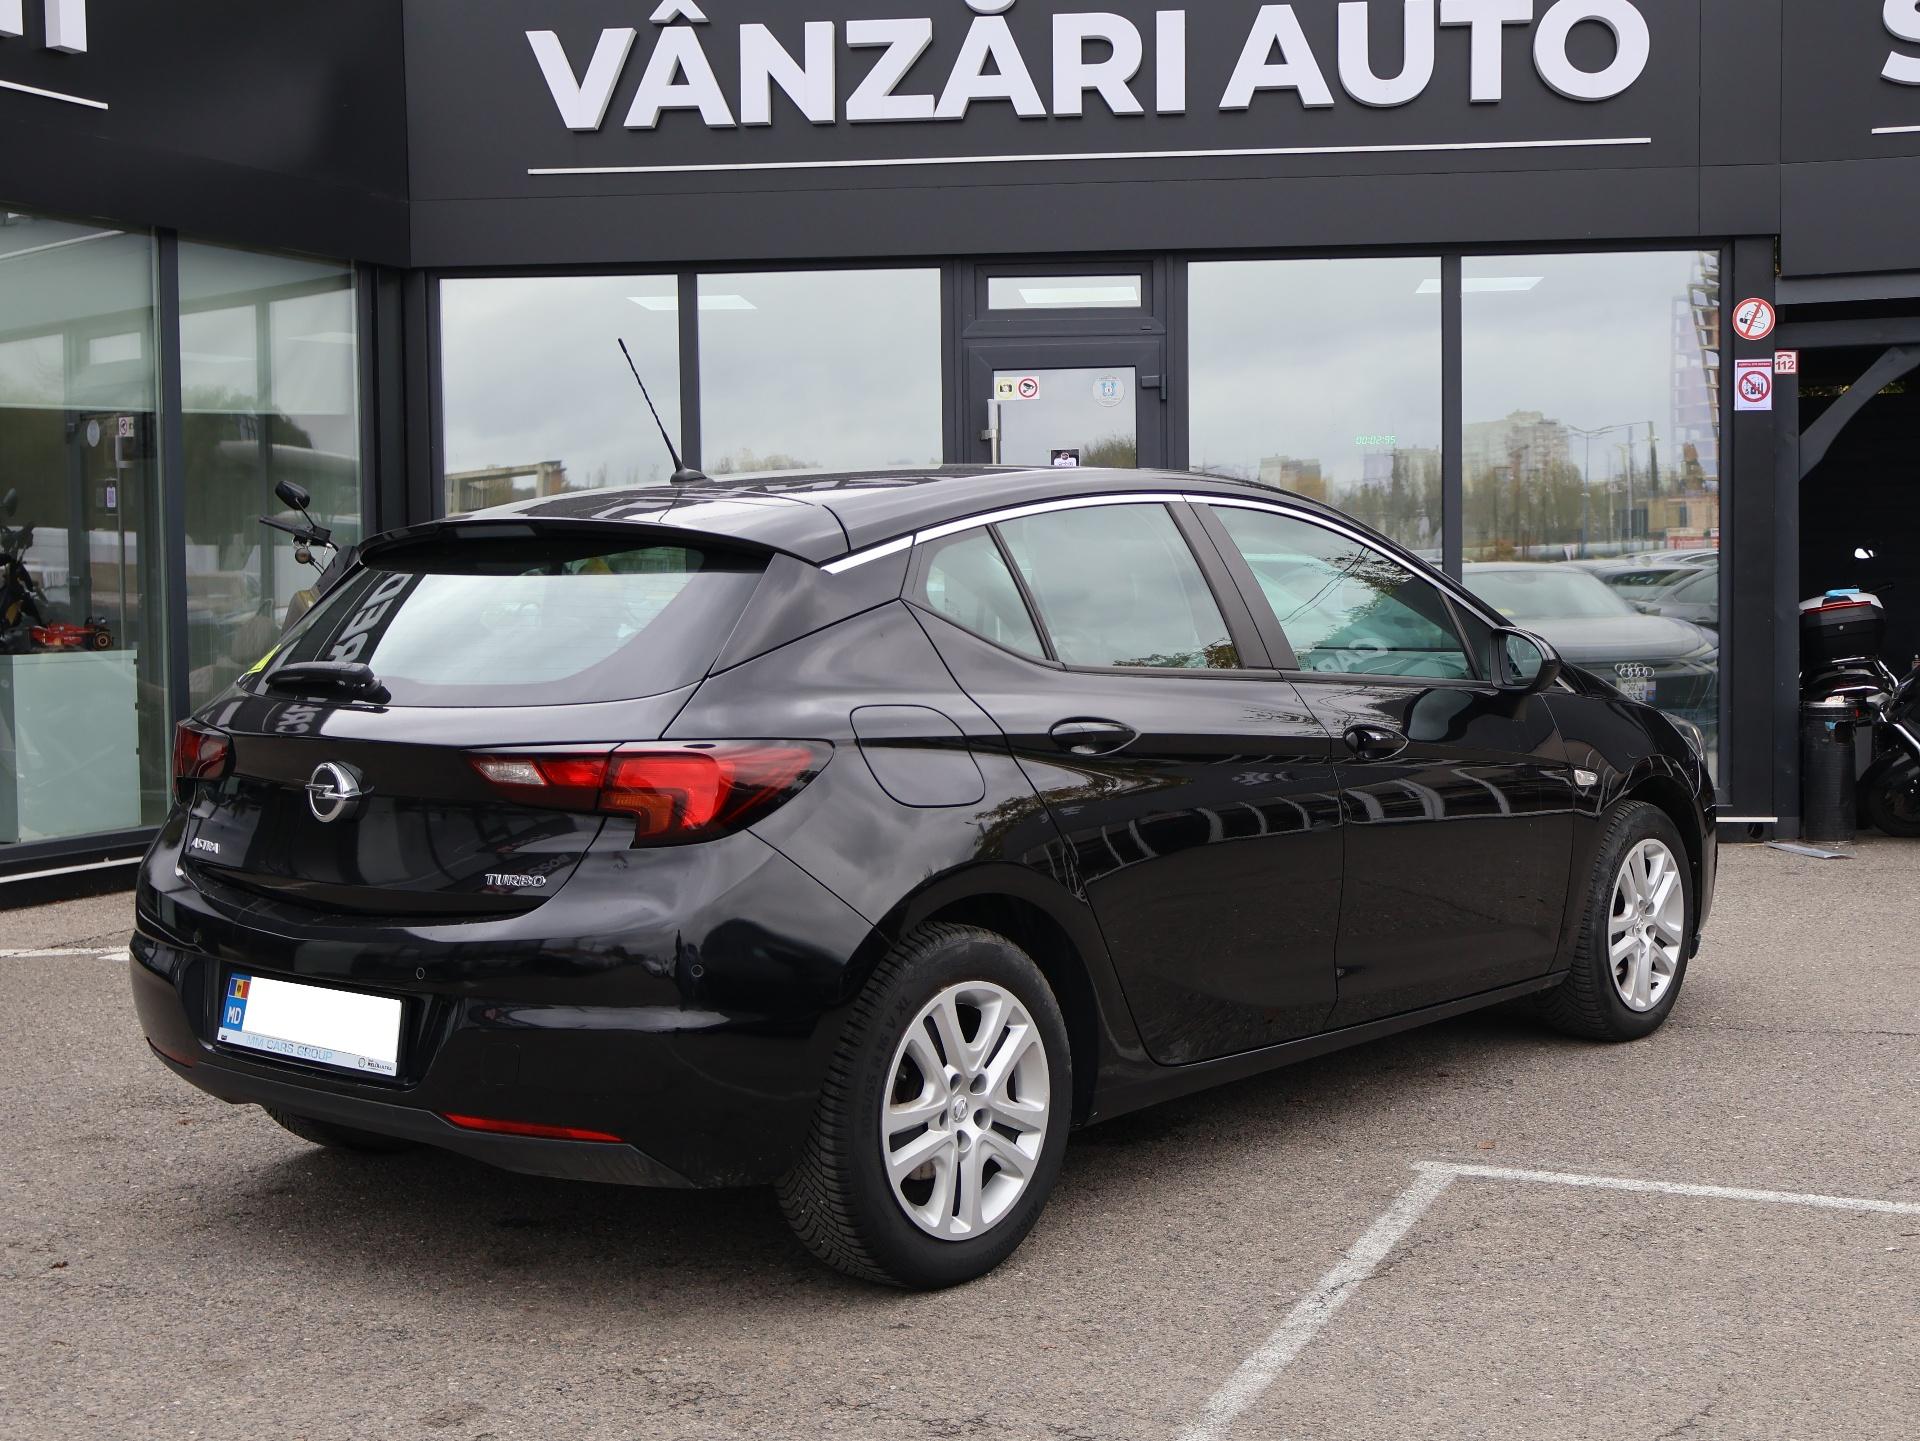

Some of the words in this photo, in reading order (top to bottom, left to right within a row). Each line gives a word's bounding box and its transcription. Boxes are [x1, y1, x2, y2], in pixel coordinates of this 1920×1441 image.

[525, 0, 1186, 131] VÂNZĂRI
[1218, 0, 1650, 110] AUTO
[1775, 360, 1795, 371] 112
[190, 837, 219, 855] ASTRA
[484, 873, 547, 888] TURBO
[226, 1006, 242, 1025] MD
[266, 1039, 295, 1055] CARS
[296, 1044, 333, 1061] GROUP
